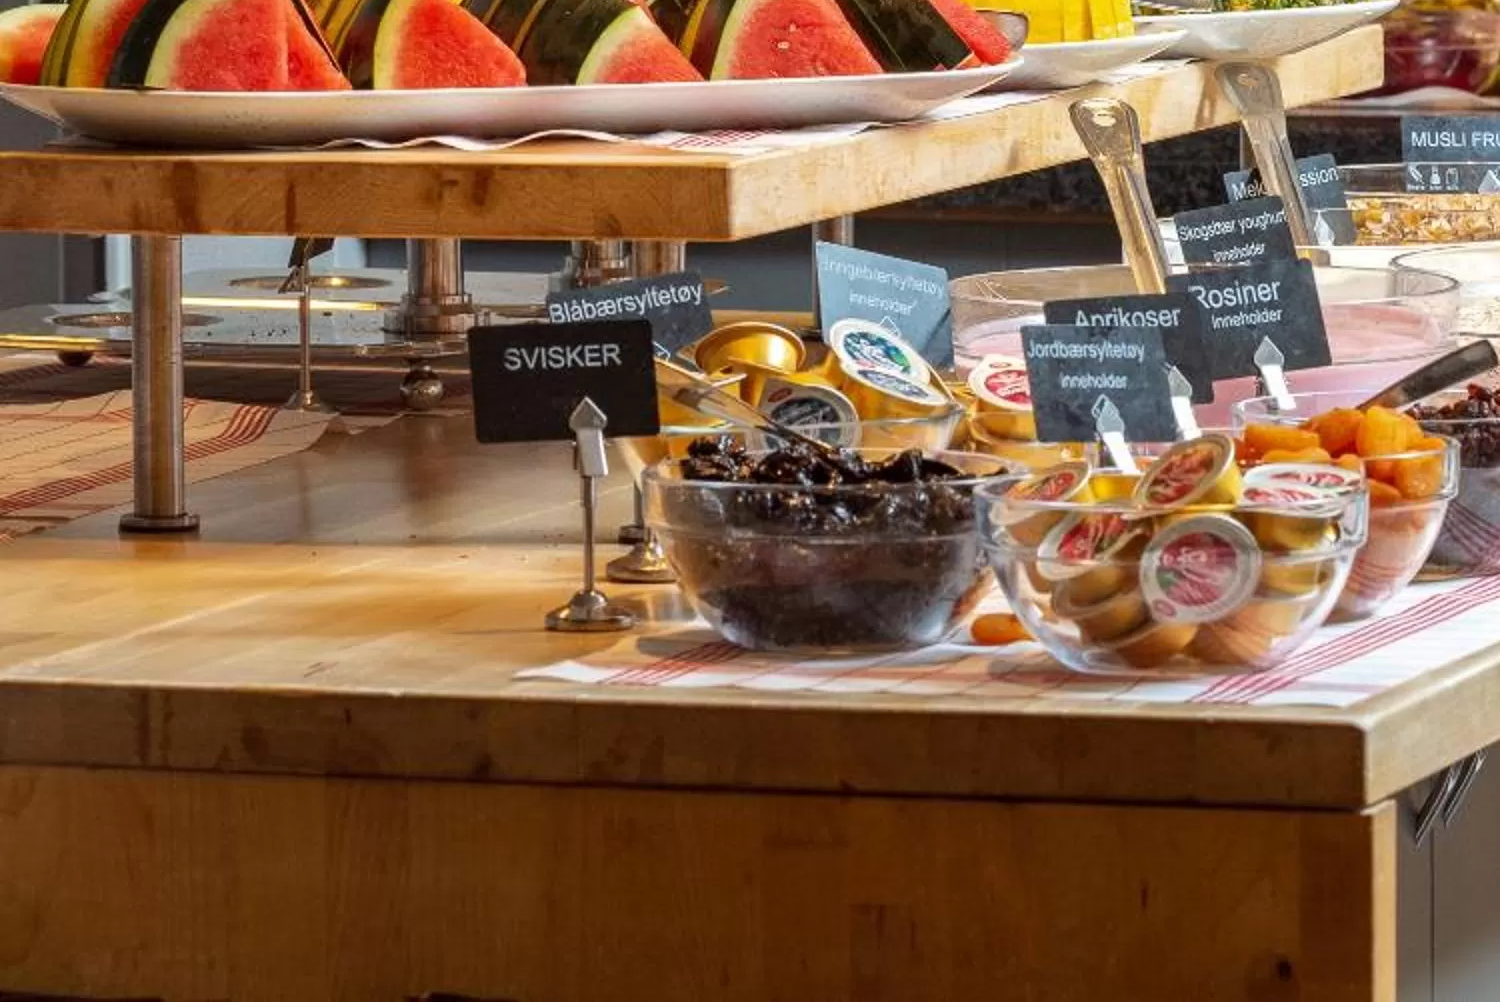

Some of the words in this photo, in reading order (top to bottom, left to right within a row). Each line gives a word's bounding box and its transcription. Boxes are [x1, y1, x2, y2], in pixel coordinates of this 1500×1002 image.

[1411, 131, 1467, 147] MUSLI
[1299, 166, 1339, 187] ssion
[549, 283, 703, 324] Blåbærsyltetøy
[1187, 279, 1280, 309] Rosiner
[1075, 307, 1181, 327] Aprikoser
[503, 343, 622, 370] SVISKER
[1027, 339, 1145, 363] Jordbærsyltetøy
